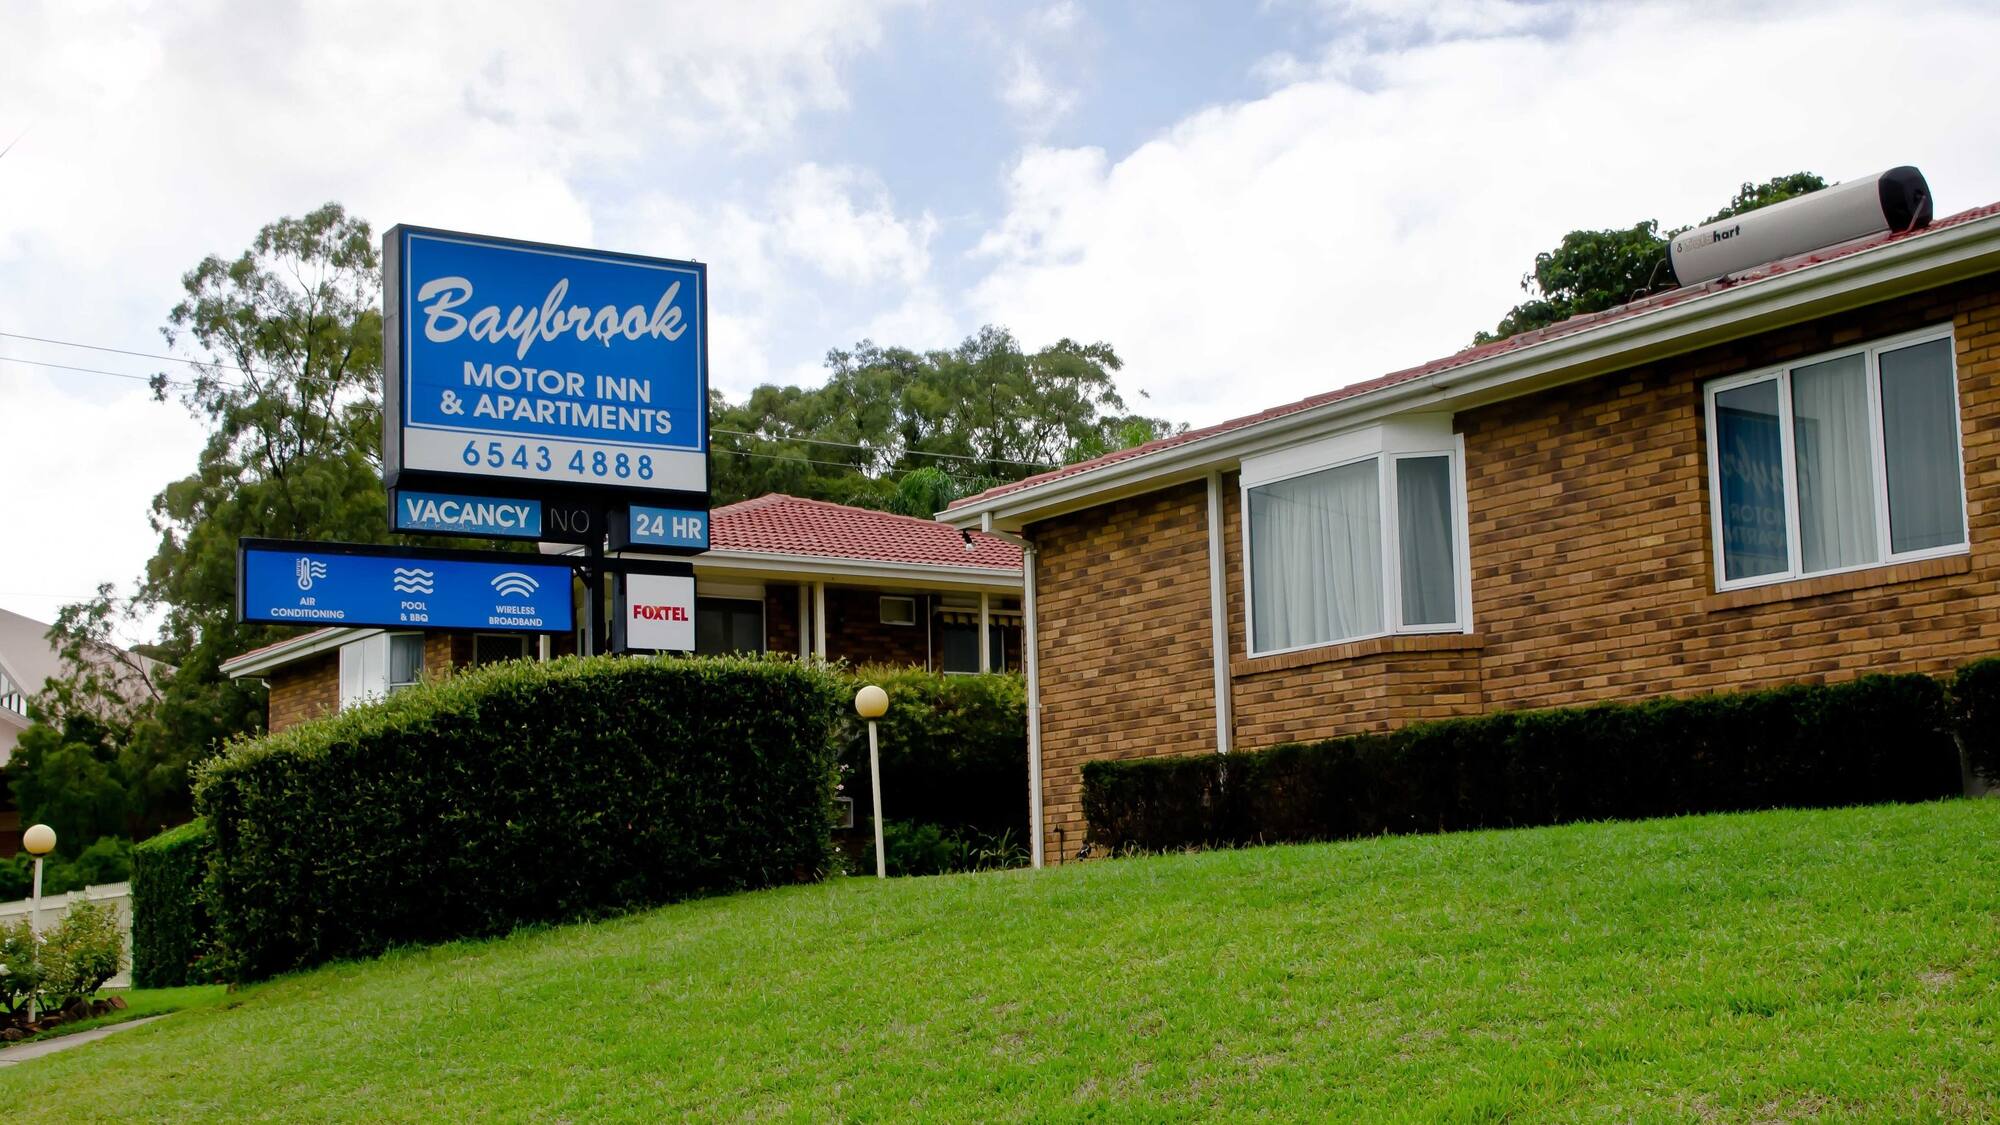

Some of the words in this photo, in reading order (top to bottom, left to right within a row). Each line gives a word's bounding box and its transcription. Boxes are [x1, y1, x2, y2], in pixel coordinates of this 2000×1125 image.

[417, 276, 688, 361] Baybrook
[463, 361, 585, 397] MOTOR
[596, 375, 651, 403] INN
[440, 389, 465, 415] &
[473, 393, 672, 435] APARTMENTS
[462, 440, 553, 472] 6543
[568, 449, 655, 480] 4888
[406, 498, 531, 529] VACANCY
[551, 508, 590, 533] NO
[636, 513, 665, 537] 24
[672, 516, 702, 540] HR
[299, 597, 316, 606] AIR
[401, 601, 427, 611] POOL
[495, 605, 536, 616] WIRELESS
[270, 607, 345, 619] CONDITIONING
[400, 613, 408, 622] &
[409, 613, 429, 623] BBQ
[488, 616, 543, 627] BROADBAND
[633, 604, 689, 622] FOXTEL
